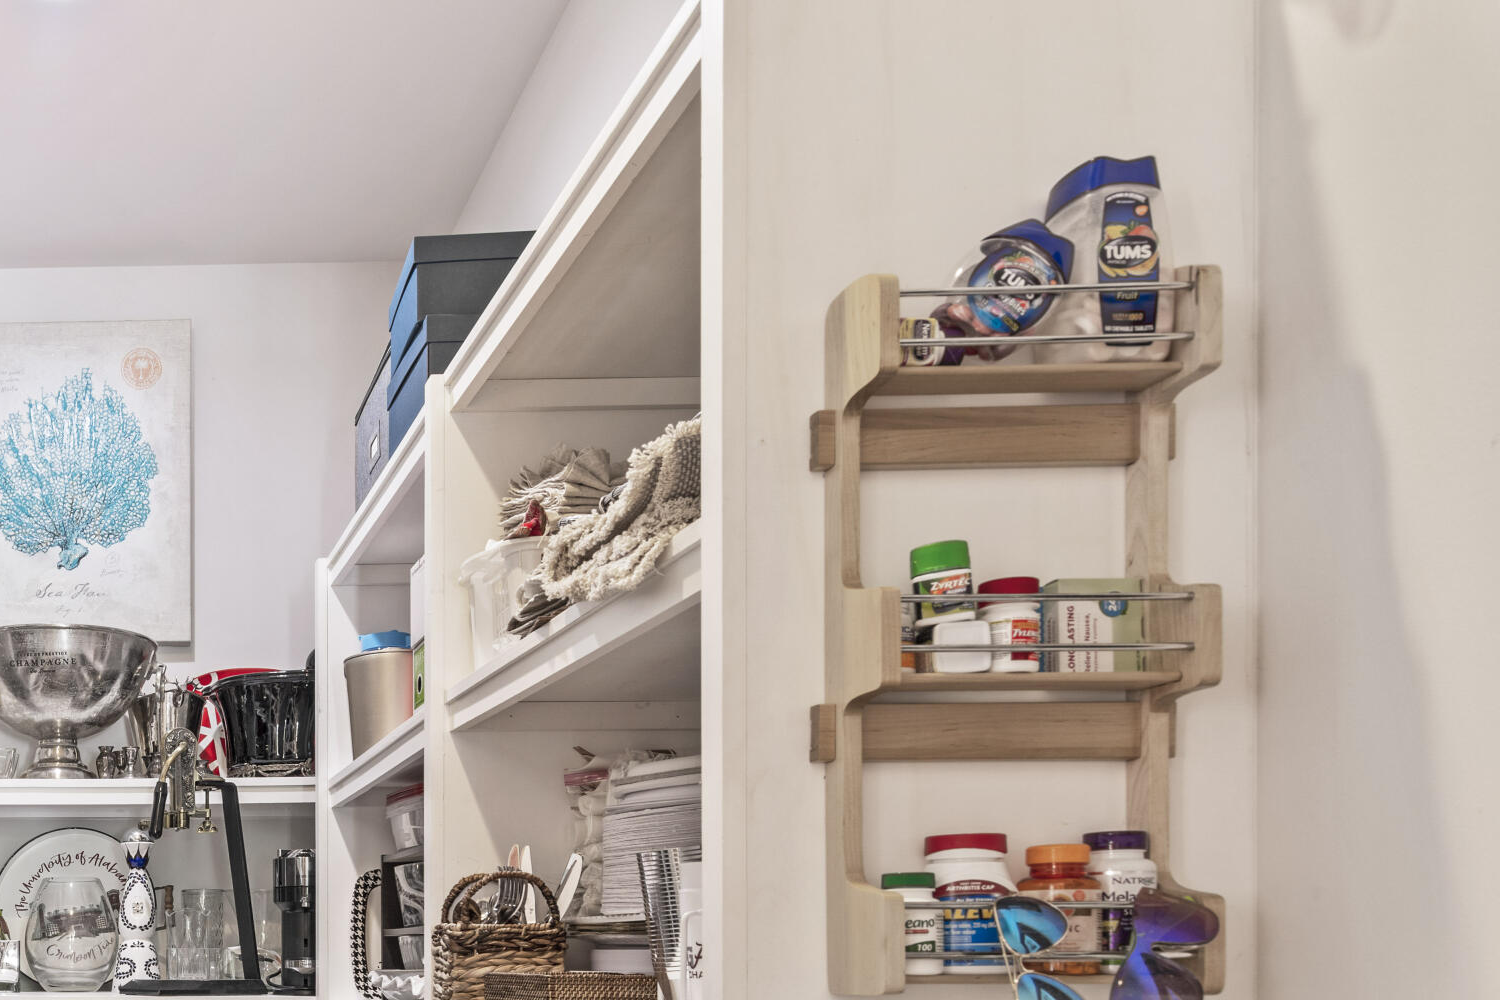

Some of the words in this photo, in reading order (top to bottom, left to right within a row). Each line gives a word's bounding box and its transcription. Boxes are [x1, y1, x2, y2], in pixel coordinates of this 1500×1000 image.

[1104, 244, 1152, 260] TUMS
[1116, 291, 1138, 300] Fruit
[930, 578, 971, 592] ZYRTEC
[9, 657, 77, 668] CHAMPAGNE
[14, 897, 29, 918] The
[75, 850, 87, 865] of
[946, 884, 980, 892] ARTHRITIS
[904, 918, 935, 929] eano
[917, 943, 933, 952] 100
